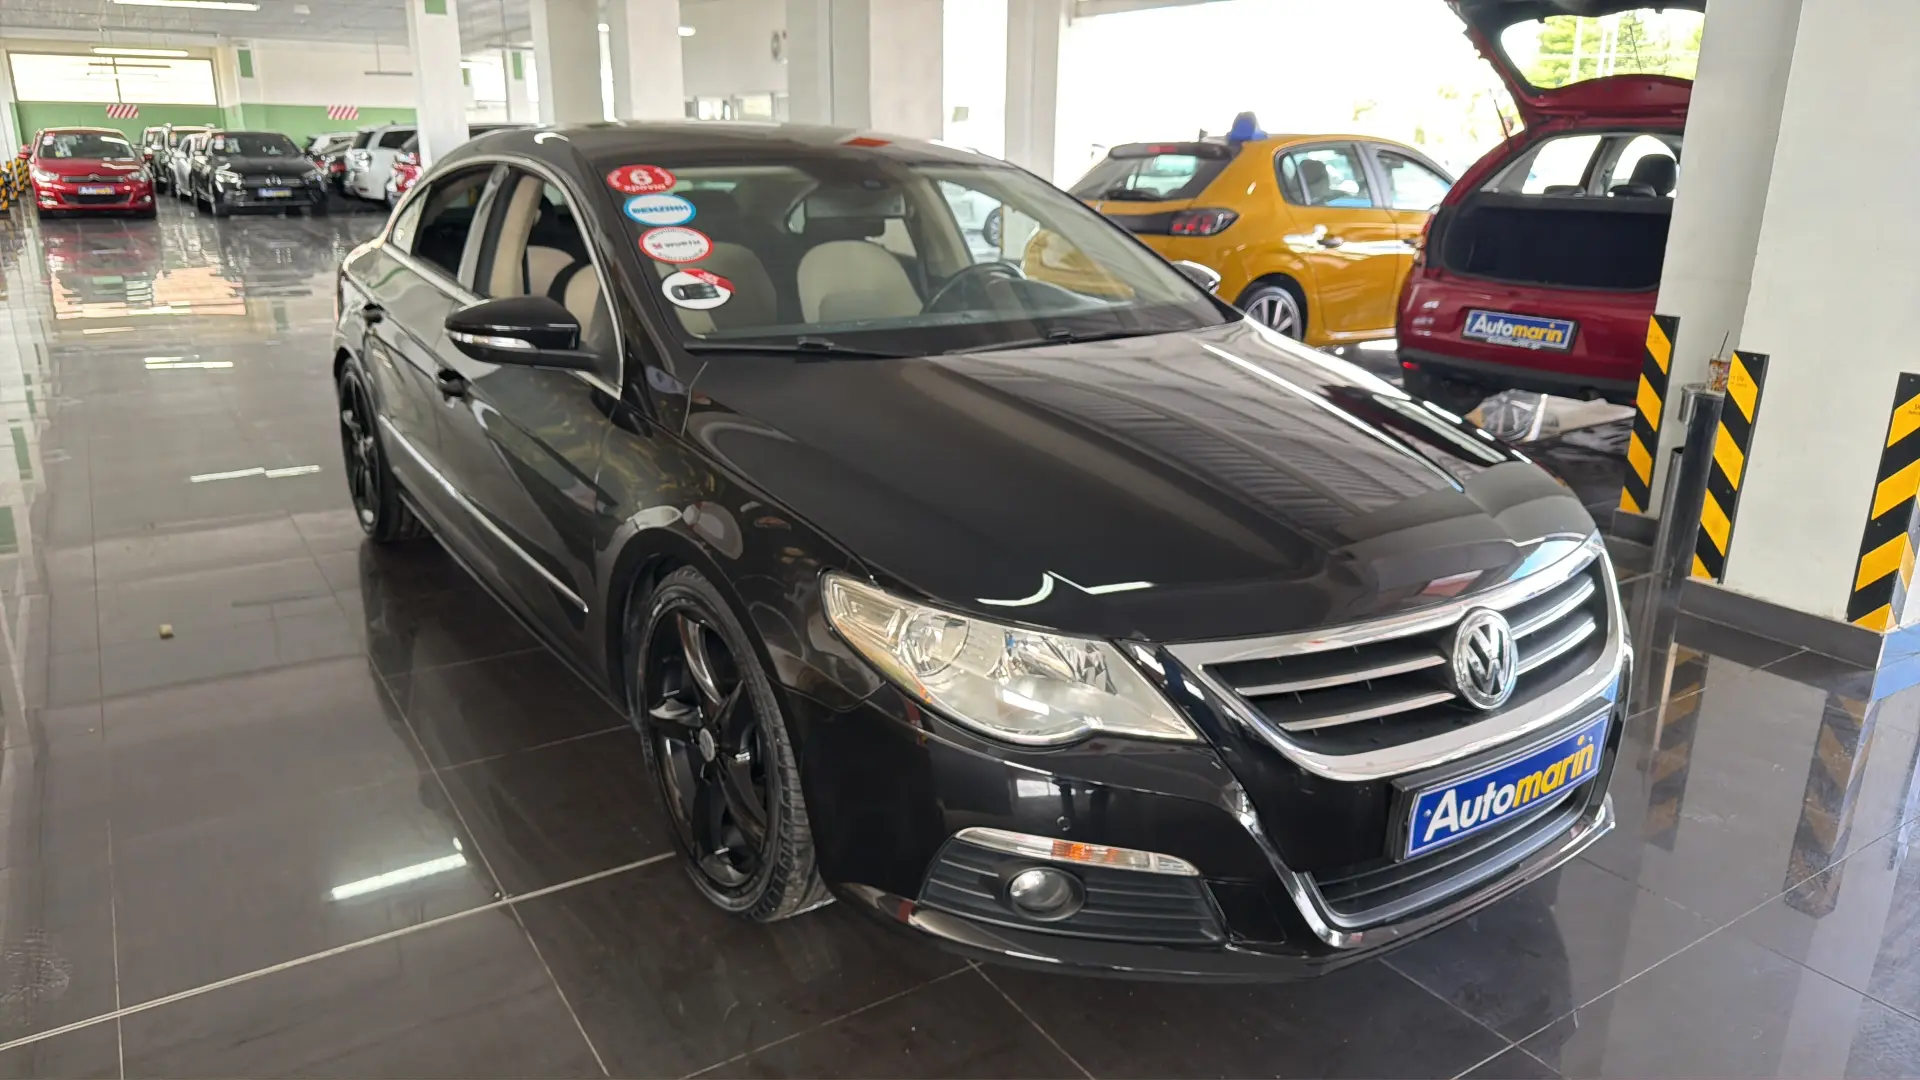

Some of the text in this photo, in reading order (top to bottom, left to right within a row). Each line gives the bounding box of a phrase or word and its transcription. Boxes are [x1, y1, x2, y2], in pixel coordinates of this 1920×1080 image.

[629, 169, 653, 185] 6
[1472, 314, 1563, 343] Automarin
[1423, 735, 1595, 842] Automarin
